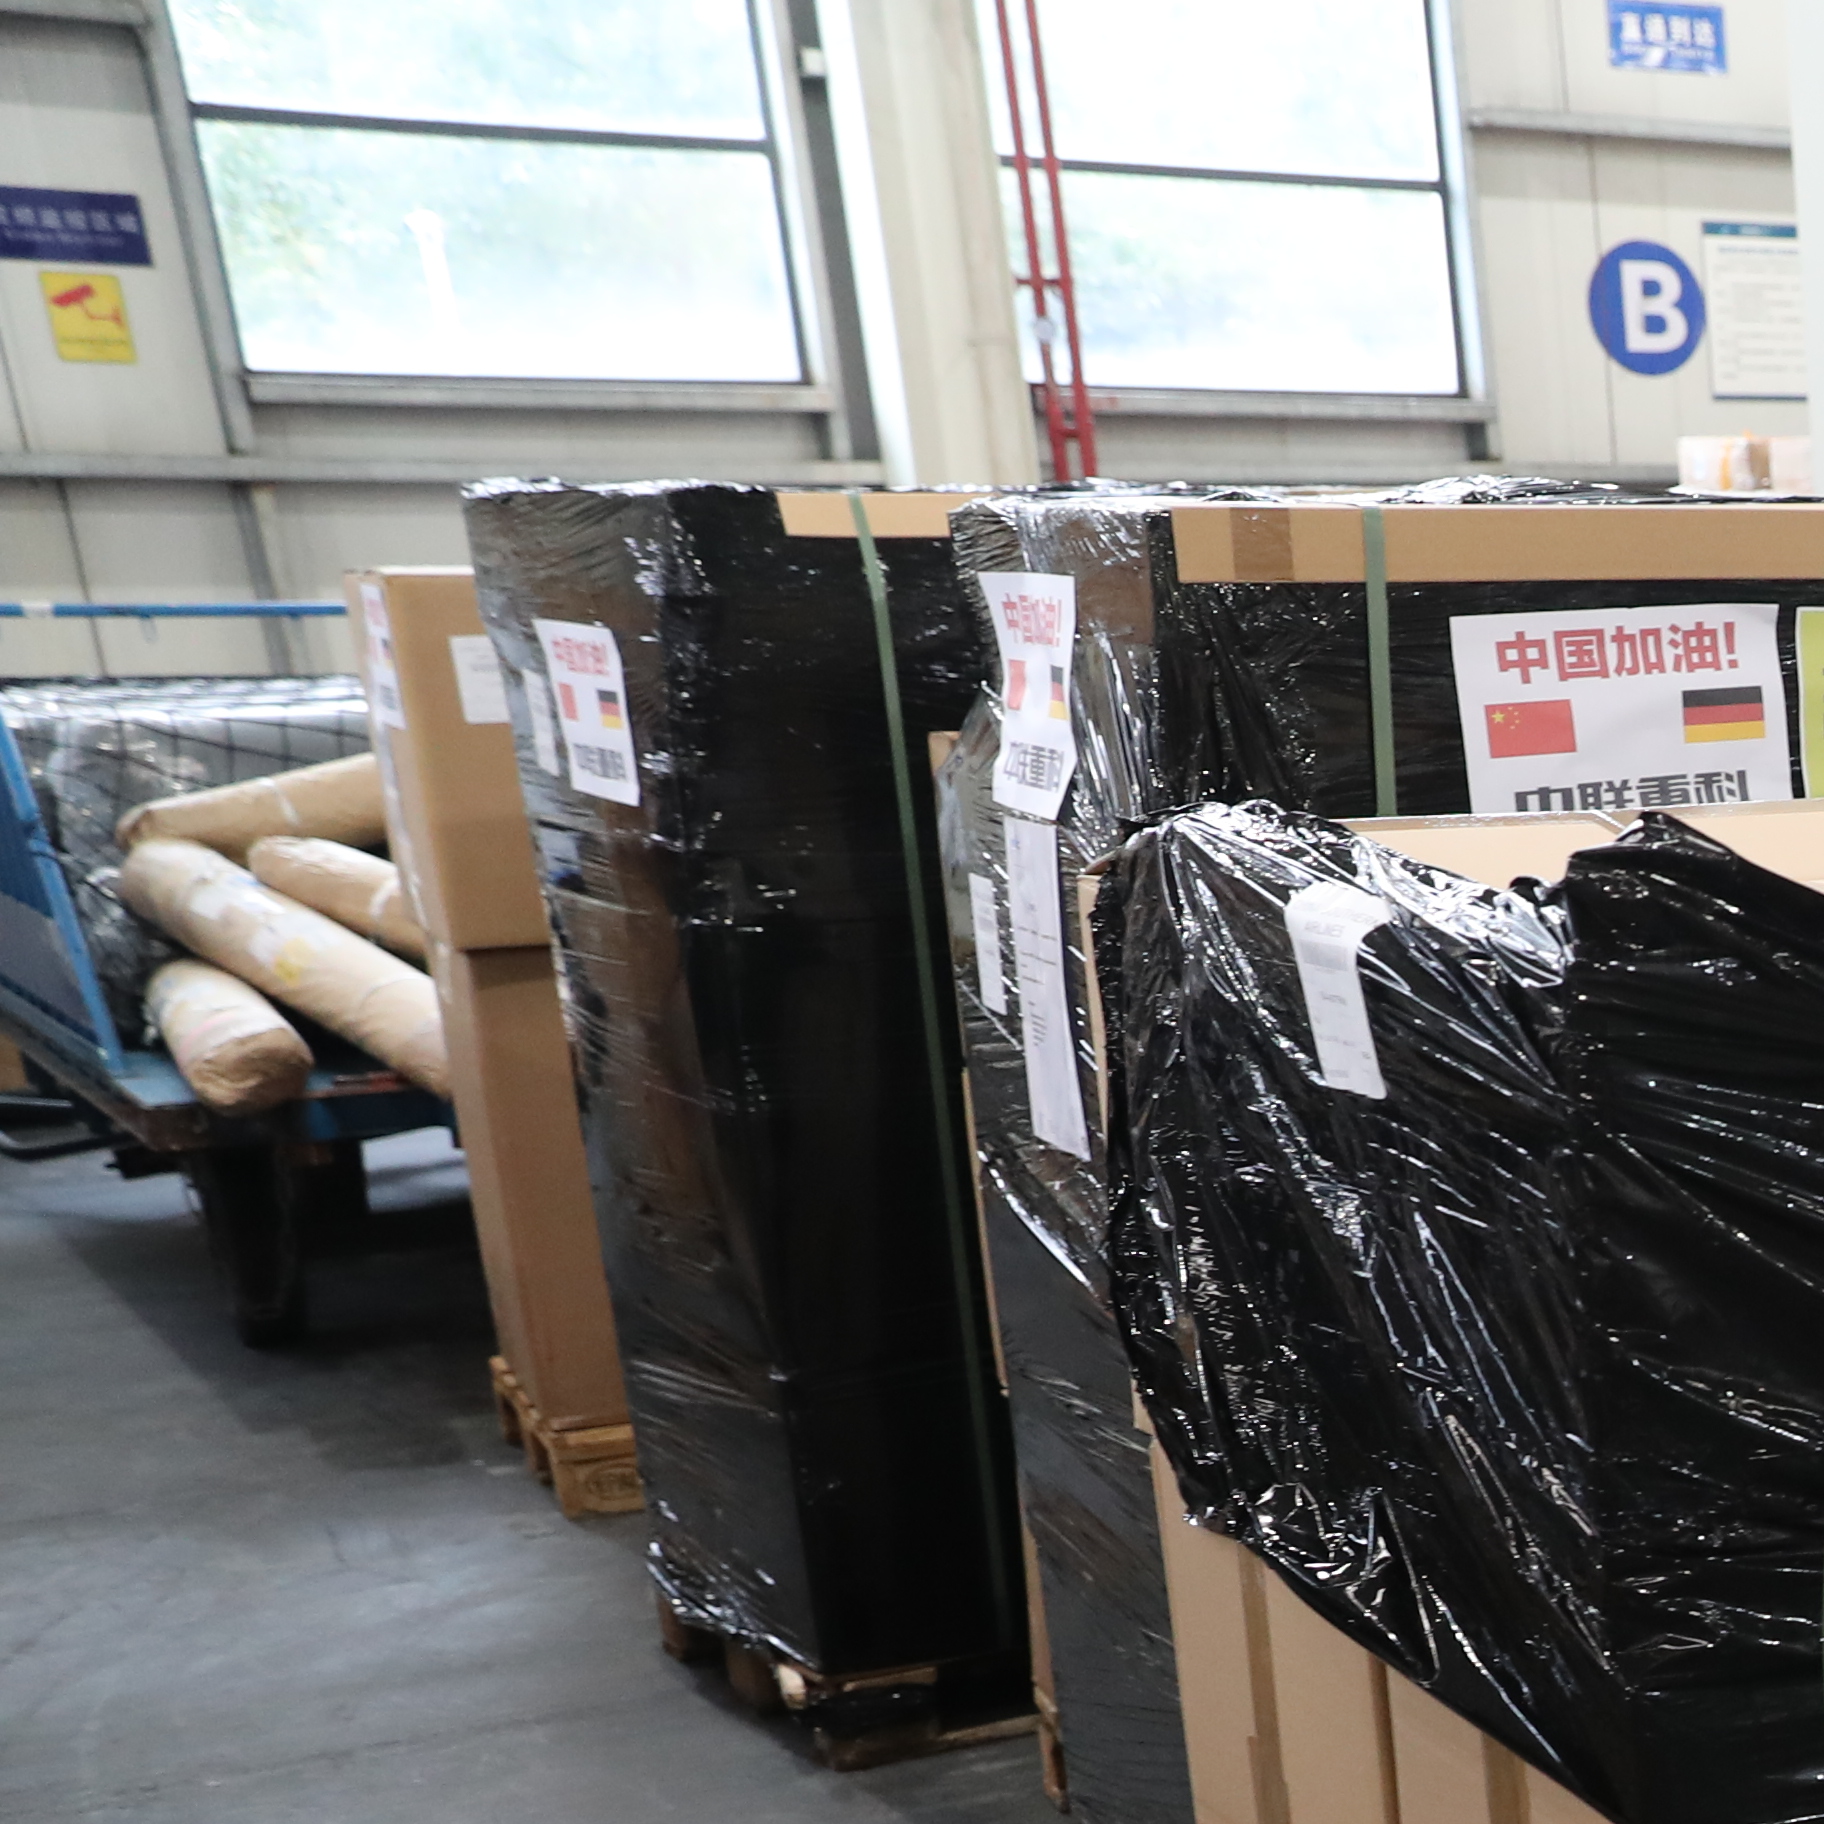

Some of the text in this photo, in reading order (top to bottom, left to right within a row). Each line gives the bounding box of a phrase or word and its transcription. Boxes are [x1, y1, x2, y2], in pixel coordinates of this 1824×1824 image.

[1619, 259, 1688, 354] B
[1495, 621, 1739, 684] 中国加油!
